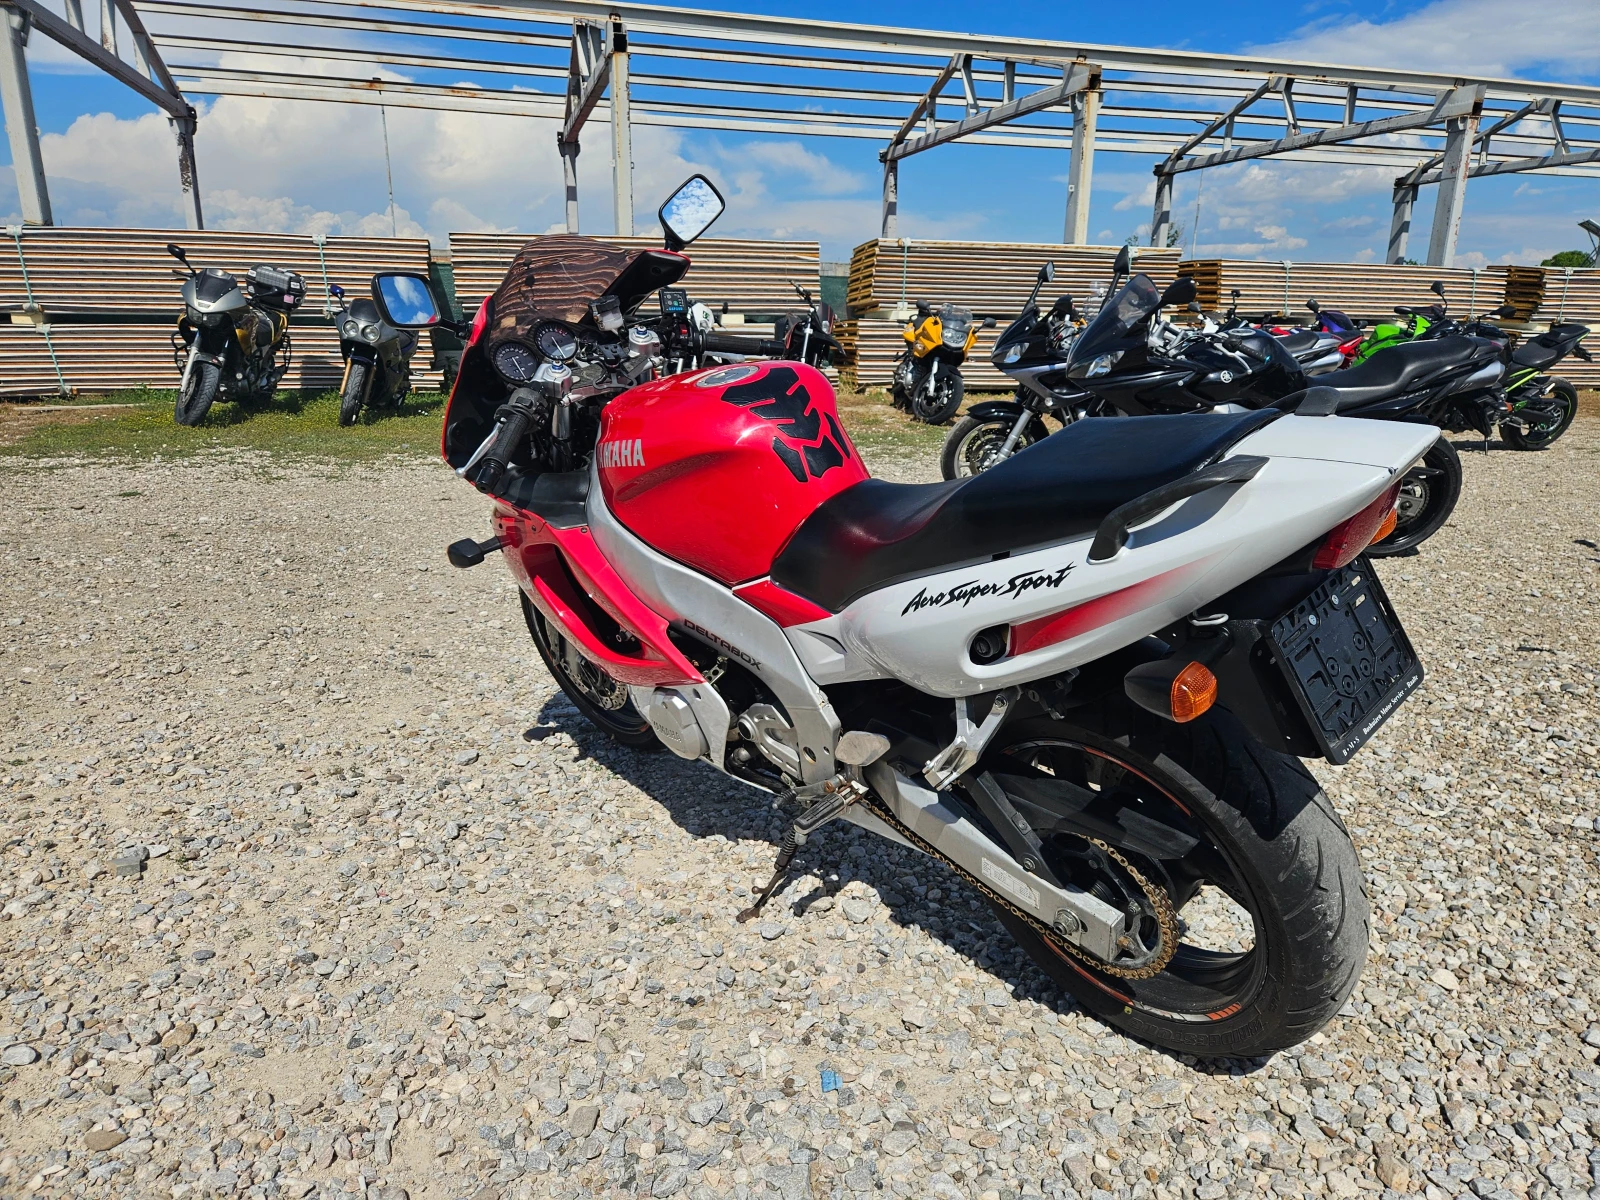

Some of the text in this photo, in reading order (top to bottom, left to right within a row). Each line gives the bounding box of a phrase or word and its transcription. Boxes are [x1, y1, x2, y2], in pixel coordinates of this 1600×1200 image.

[900, 560, 1077, 617] Aero Super Sport
[684, 618, 762, 671] DELTABOX
[1390, 690, 1405, 705] Service
